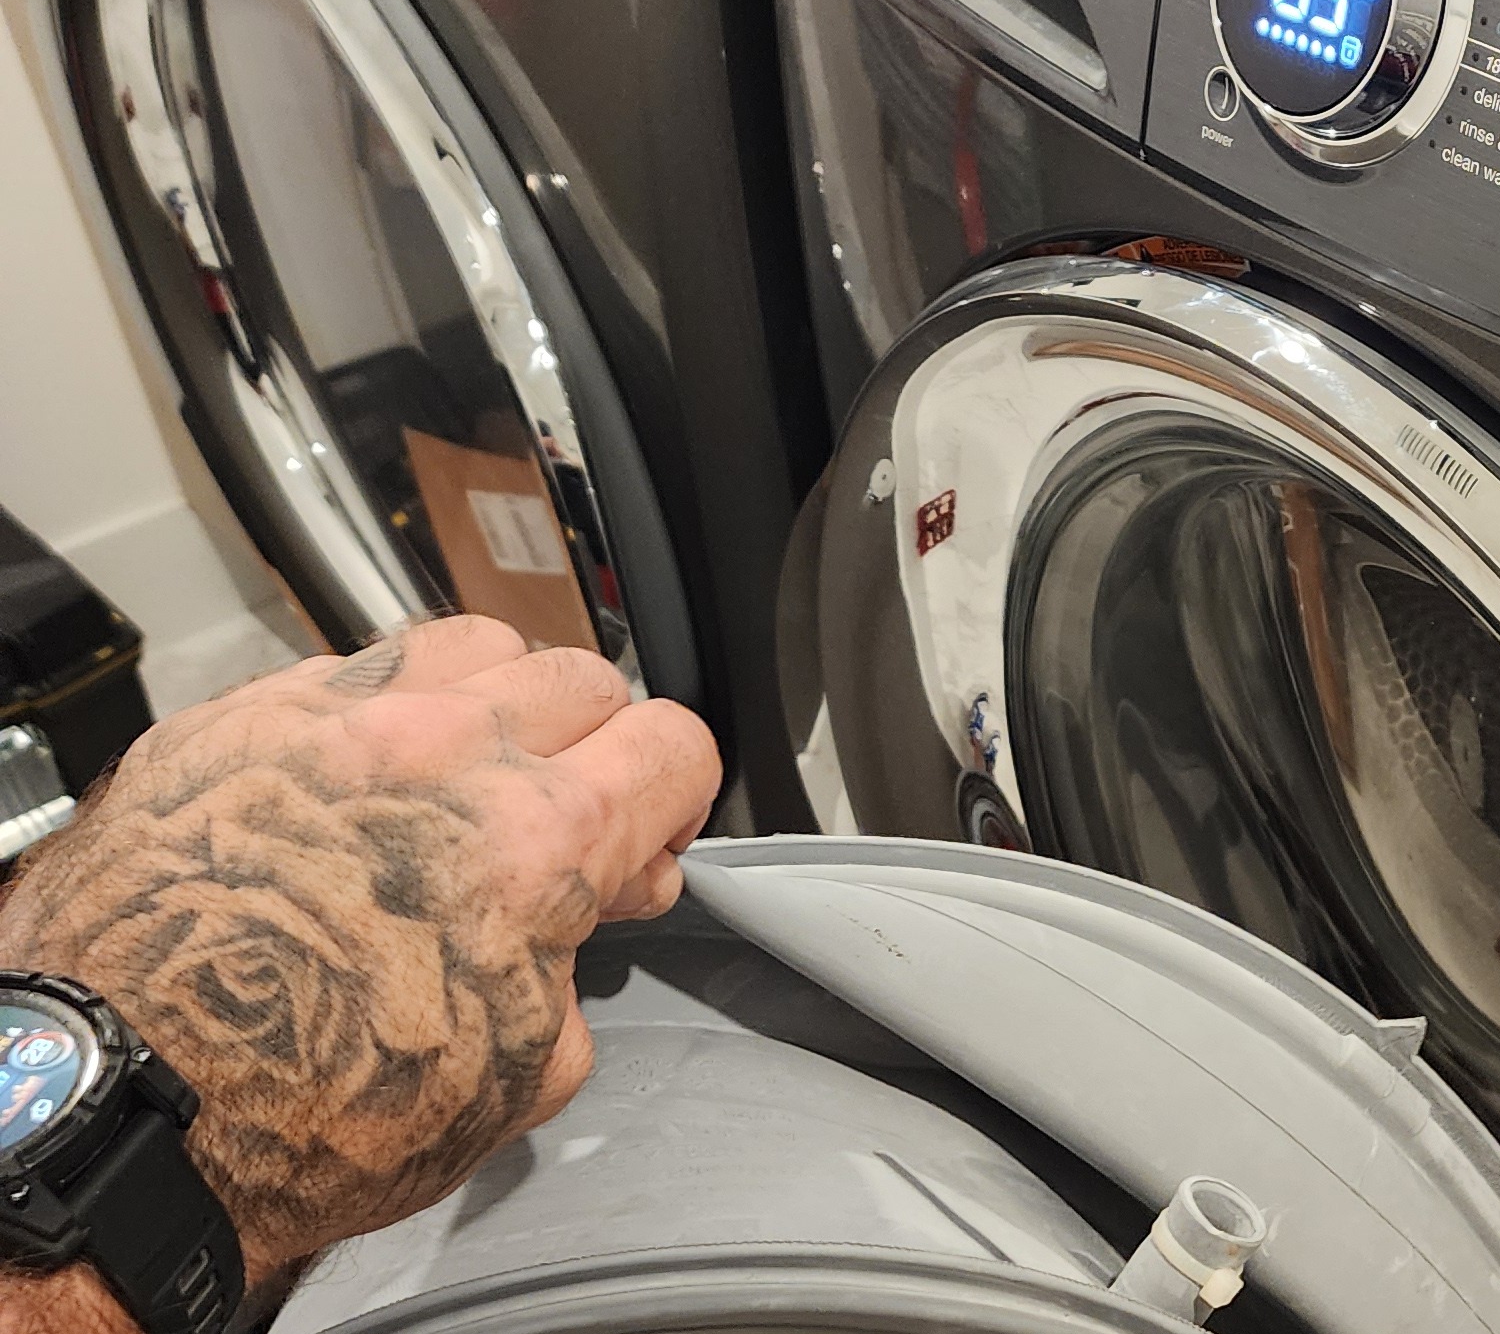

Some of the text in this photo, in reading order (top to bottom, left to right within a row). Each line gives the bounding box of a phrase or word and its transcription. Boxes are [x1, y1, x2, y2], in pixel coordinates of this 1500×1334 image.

[1201, 125, 1234, 148] power
[1458, 118, 1495, 146] rinse
[1441, 146, 1479, 176] clean
